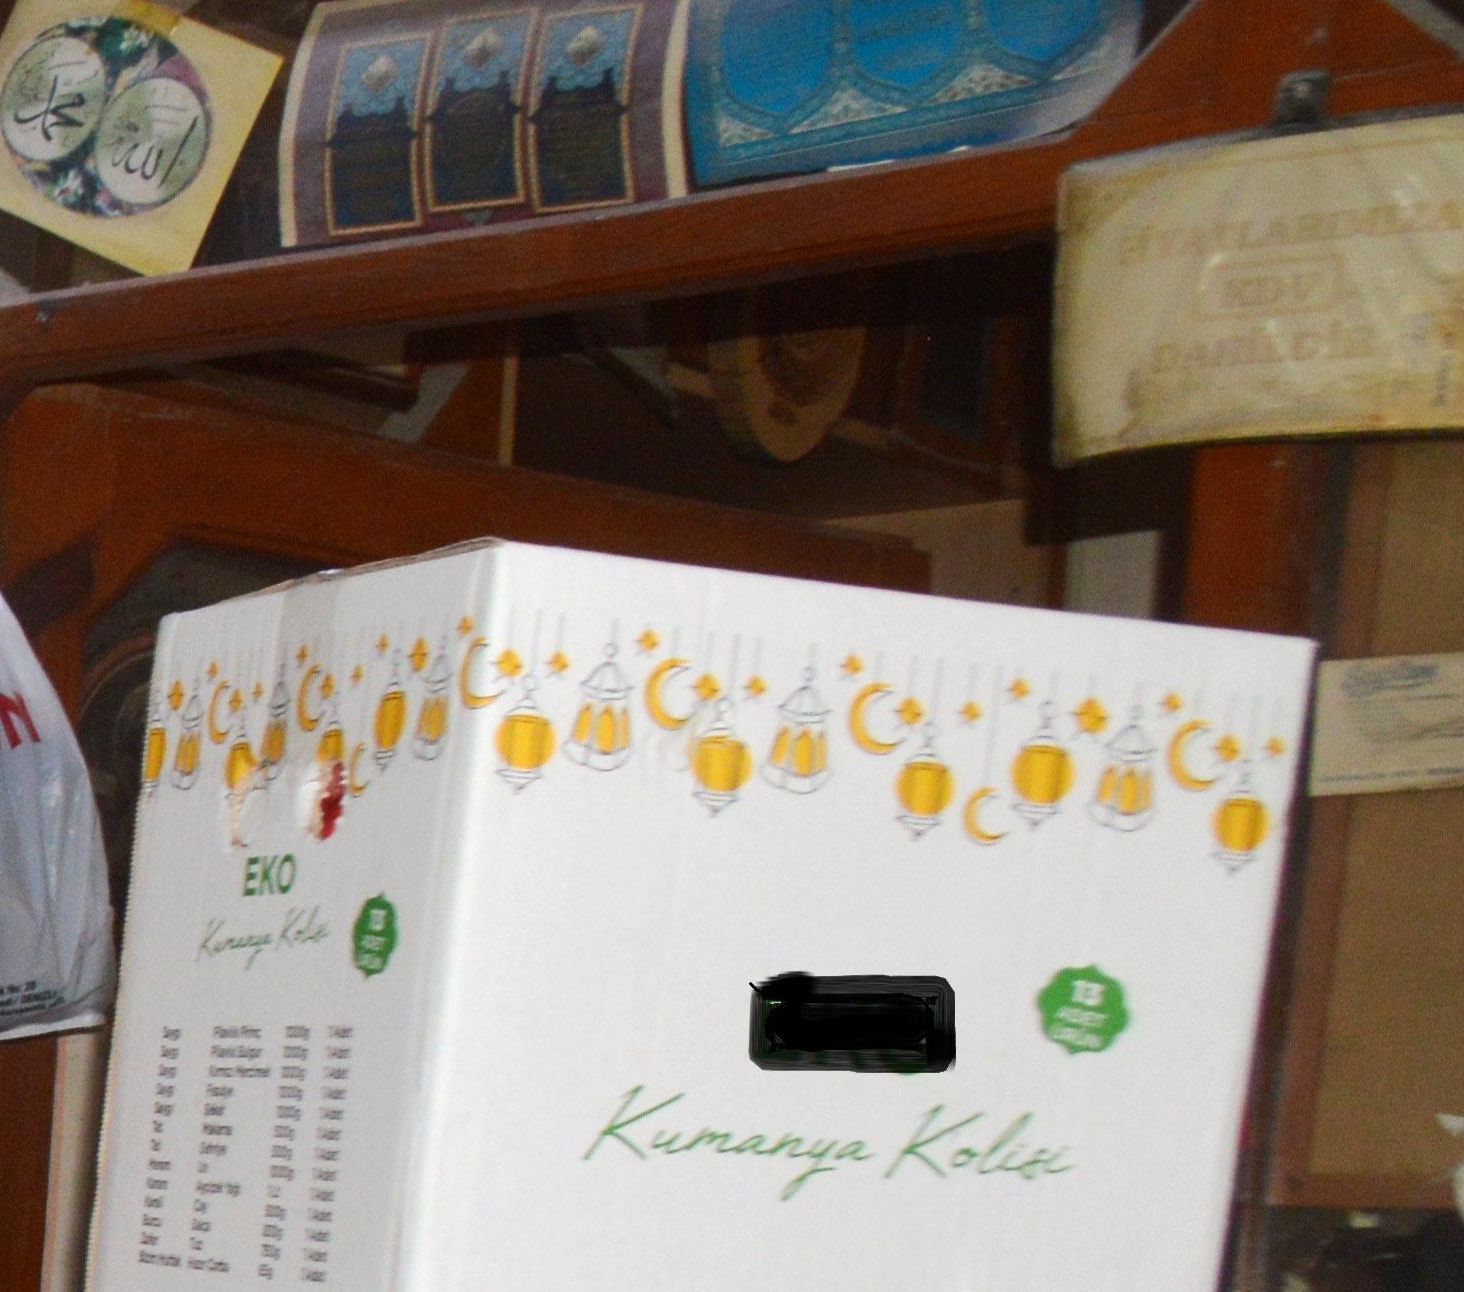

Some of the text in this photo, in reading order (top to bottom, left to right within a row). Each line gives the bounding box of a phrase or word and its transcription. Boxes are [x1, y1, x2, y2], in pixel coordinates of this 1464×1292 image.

[242, 853, 296, 897] EKO
[1072, 979, 1106, 1005] 13
[583, 1084, 1076, 1201] Kumanya Kolisi
